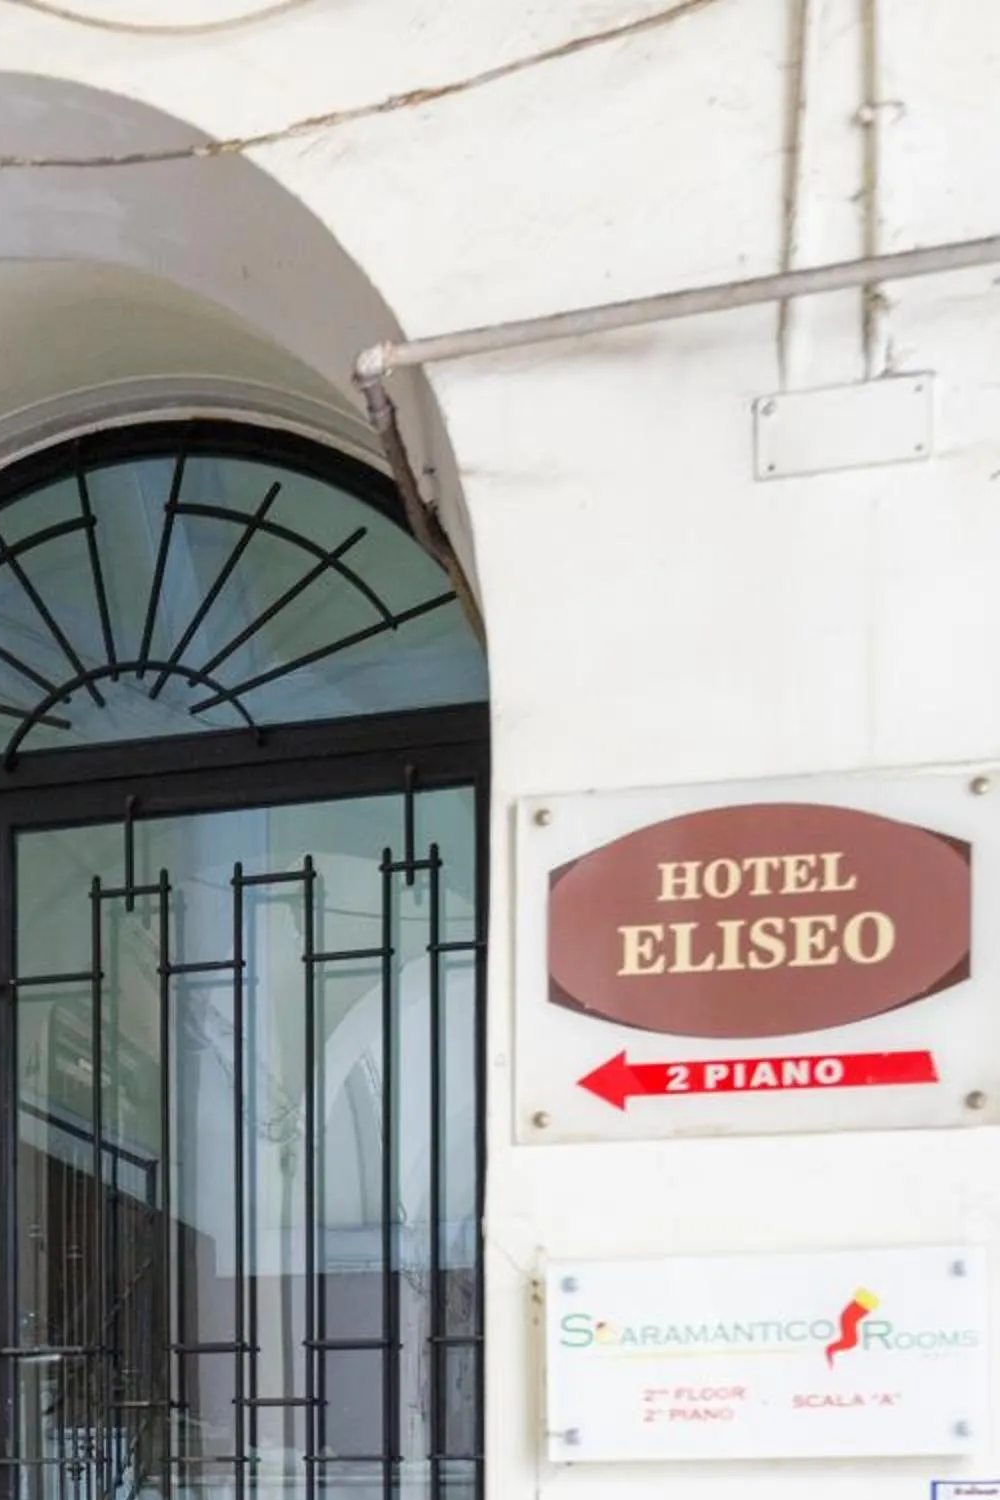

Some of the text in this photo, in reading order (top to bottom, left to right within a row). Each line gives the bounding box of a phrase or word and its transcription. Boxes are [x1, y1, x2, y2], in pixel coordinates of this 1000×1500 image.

[657, 852, 857, 902] HOTEL
[617, 911, 896, 977] ELISEO
[666, 1058, 845, 1092] 2 PIANO
[559, 1313, 836, 1348] SARAMANTICO
[674, 1386, 746, 1401] FLOOR
[792, 1392, 866, 1409] SCALA
[668, 1406, 735, 1422] PIANO
